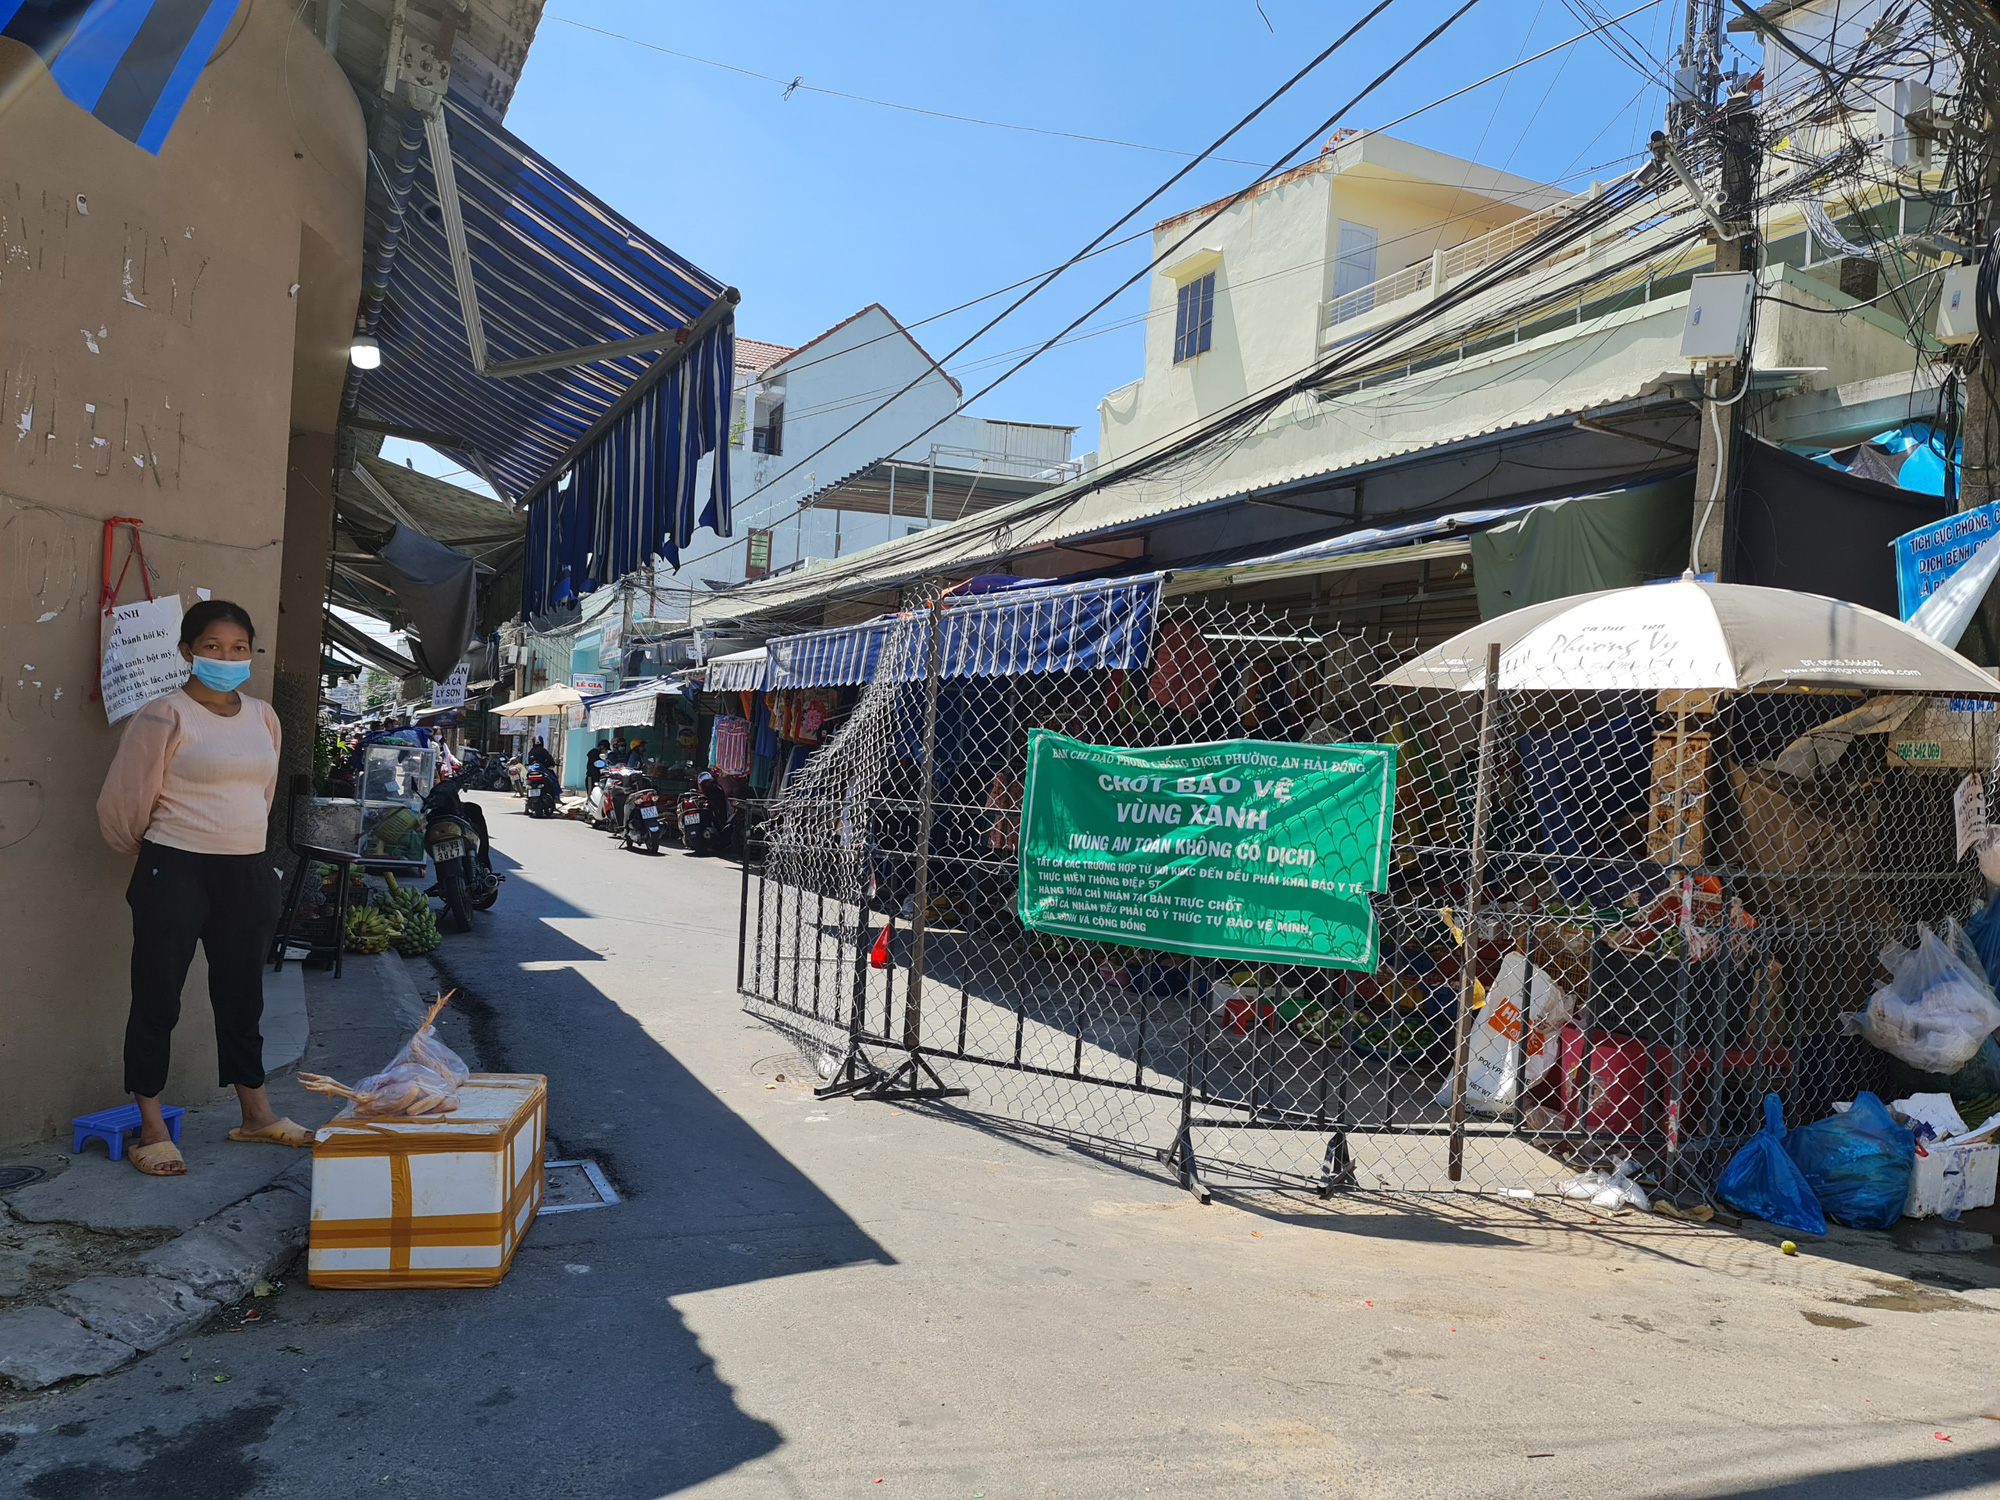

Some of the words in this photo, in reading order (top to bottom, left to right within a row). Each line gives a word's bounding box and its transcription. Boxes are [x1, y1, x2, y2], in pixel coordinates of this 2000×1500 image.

[1910, 534, 1930, 554] TÍCH
[1934, 527, 1953, 546] CỰC
[1920, 556, 1942, 576] DỊCH
[1946, 545, 1970, 566] BỆNH
[1920, 578, 1929, 597] LÀ
[122, 635, 141, 646] bánh
[125, 658, 145, 668] canh:
[146, 654, 159, 663] bột
[151, 675, 164, 684] lác,
[436, 687, 445, 697] LÝ
[446, 688, 460, 697] SƠN
[1052, 748, 1068, 759] BAN
[1151, 756, 1189, 769] CHỐNG
[1191, 755, 1222, 769] DỊCH
[1225, 752, 1278, 767] PHƯỜNG
[1282, 757, 1300, 769] AN
[1304, 756, 1328, 771] HẢI
[1098, 774, 1168, 793] CHỐT
[1254, 776, 1294, 804] VỆ
[1116, 798, 1182, 824] VÙNG
[1188, 804, 1268, 831] XANH
[1068, 831, 1109, 851] (VÙNG
[1111, 837, 1131, 852] AN
[1134, 834, 1172, 854] TOÀN
[1175, 836, 1232, 858] KHÔNG
[1237, 840, 1260, 861] CÓ
[1267, 846, 1316, 868] DỊCH)
[1036, 855, 1051, 867] TẤT
[1065, 858, 1080, 869] CÁC
[1083, 860, 1116, 872] TRƯỜNG
[1118, 863, 1136, 874] HỢP
[1139, 863, 1152, 874] TỪ
[1171, 866, 1196, 877] KHÁC
[1200, 866, 1223, 879] ĐẾN
[1226, 868, 1249, 882] ĐỀU
[1253, 872, 1279, 885] PHẢI
[1282, 876, 1308, 888] KHAI
[1311, 879, 1335, 890] BÁO
[1338, 882, 1345, 892] Y
[1038, 872, 1060, 882] THỰC
[1063, 873, 1086, 883] HIỆN
[1088, 874, 1119, 886] THÔNG
[1122, 878, 1145, 888] ĐIỆP
[1039, 885, 1064, 895] HÀNG
[1066, 887, 1082, 897] HÓA
[1104, 890, 1130, 901] NHẬN
[1132, 893, 1147, 904] TẠI
[1150, 893, 1172, 904] BÀN
[1174, 896, 1204, 909] TRỰC
[1208, 898, 1242, 912] CHỐT
[1059, 899, 1069, 909] CÁ
[1072, 900, 1098, 911] NHÂN
[1100, 902, 1117, 913] ĐỀU
[1120, 905, 1143, 916] PHẢI
[1146, 907, 1159, 918] CÓ
[1162, 908, 1169, 919] Ý
[1172, 910, 1202, 923] THỨC
[1205, 914, 1223, 927] TỰ
[1226, 917, 1253, 929] BẢO
[1257, 919, 1273, 932] VỆ
[1277, 922, 1313, 936] MÌNH,
[1092, 917, 1118, 929] CỘNG
[1120, 918, 1146, 932] ĐỒNG
[1469, 1082, 1482, 1091] NET
